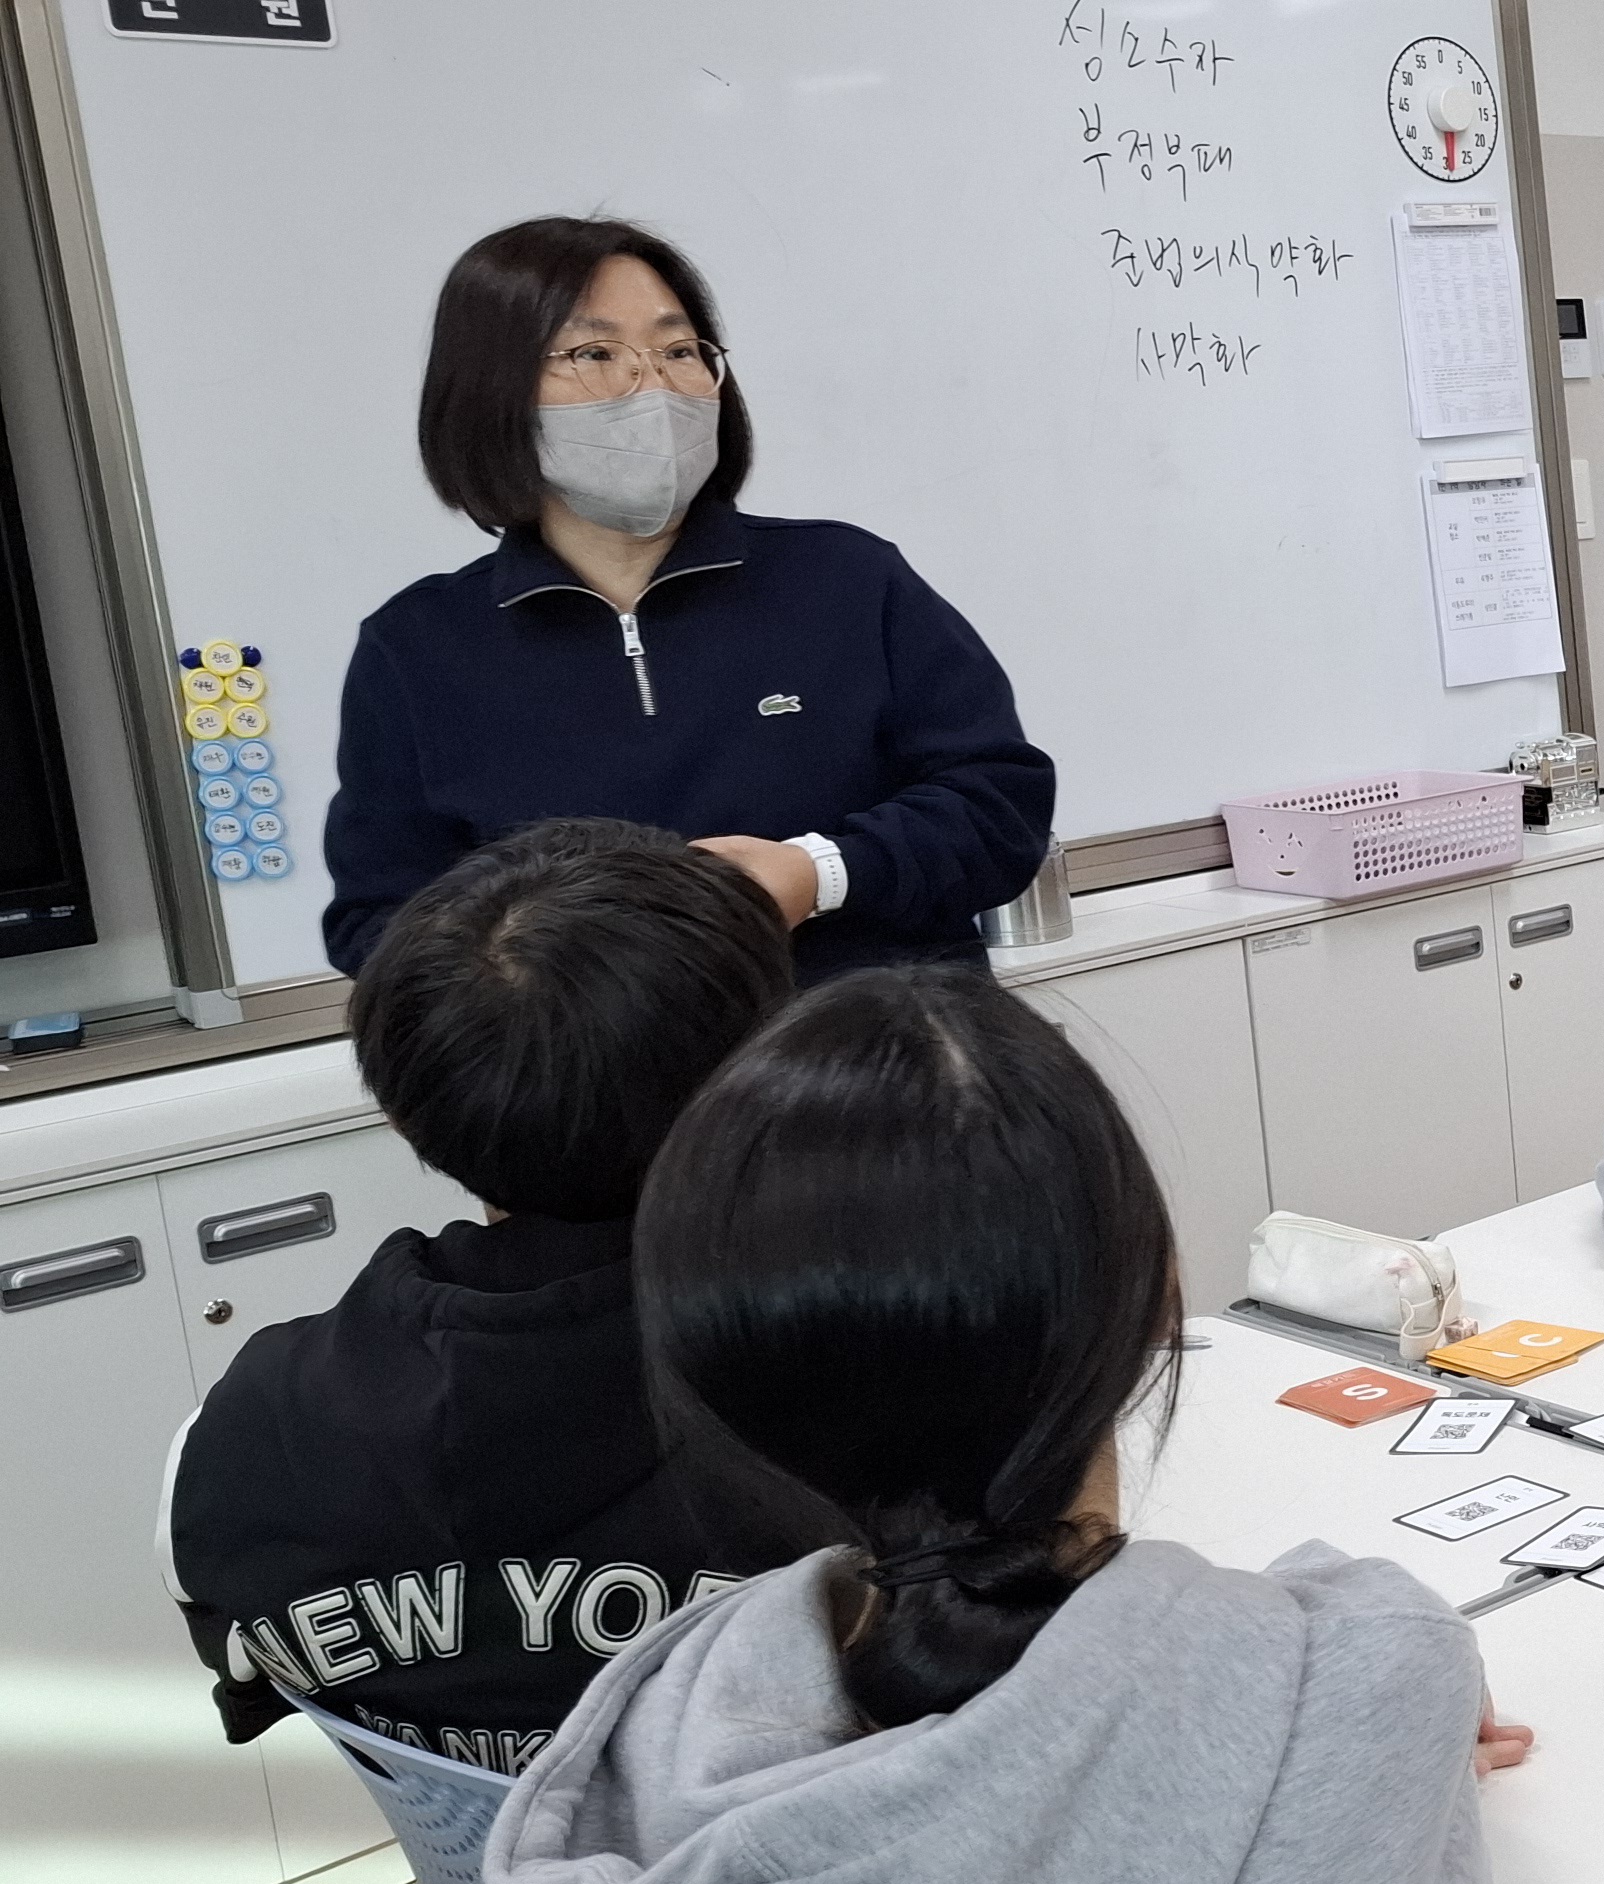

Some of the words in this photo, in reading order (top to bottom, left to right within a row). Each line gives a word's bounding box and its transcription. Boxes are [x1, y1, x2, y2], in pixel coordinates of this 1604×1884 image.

[1415, 54, 1427, 69] 55
[1437, 49, 1444, 63] 0
[1457, 60, 1463, 74] 5
[1402, 71, 1413, 86] 50
[1471, 81, 1482, 95] 10
[1398, 97, 1409, 112] 45
[1478, 107, 1489, 122] 15
[1406, 125, 1417, 140] 40
[1475, 133, 1486, 148] 20
[1078, 103, 1233, 202] 부정부패
[1422, 146, 1433, 161] 35
[1462, 150, 1473, 165] 25
[1101, 229, 1260, 298] 준법의식
[1270, 235, 1354, 297] 약화
[1136, 321, 1262, 387] 사막화
[1518, 1333, 1564, 1347] C
[1341, 1383, 1389, 1401] S
[236, 1561, 465, 1696] NEW
[499, 1558, 754, 1658] YO
